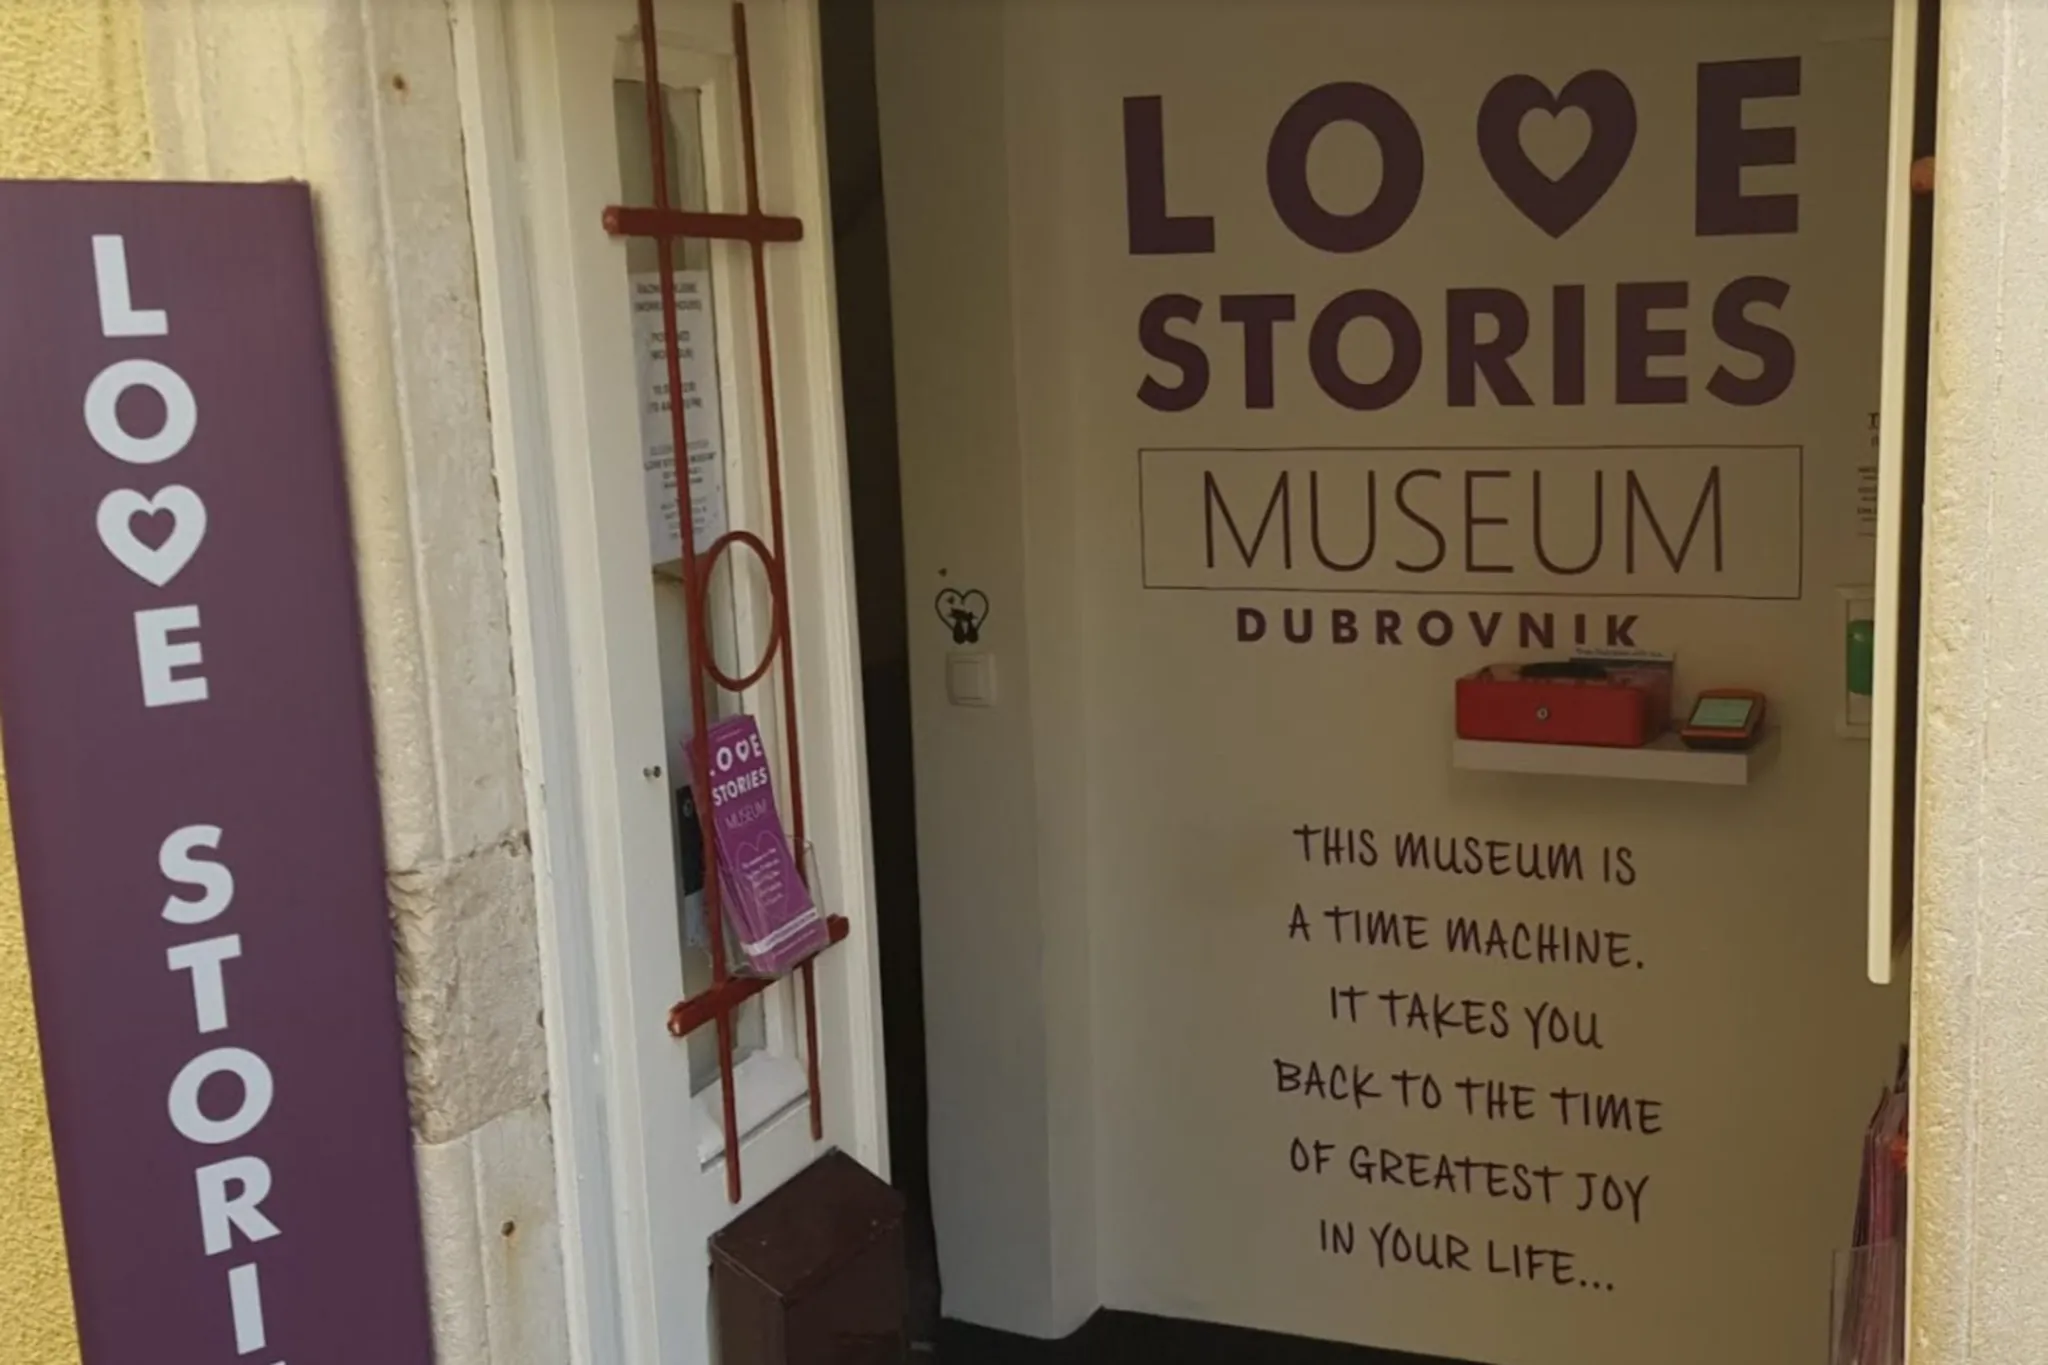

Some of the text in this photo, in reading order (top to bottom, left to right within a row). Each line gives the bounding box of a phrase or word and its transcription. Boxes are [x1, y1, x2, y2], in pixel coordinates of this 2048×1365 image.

[1137, 275, 1796, 412] STORIES
[1202, 466, 1723, 576] MUSEUM
[1236, 608, 1640, 649] DUBROVNIK
[712, 767, 768, 806] STORIES
[1293, 824, 1636, 886] THIS MUSEUM IS
[1288, 903, 1644, 969] A TIME MACHINE.
[1330, 985, 1604, 1050] IT TAKES YOU
[158, 824, 286, 1365] STORI
[1273, 1059, 1662, 1135] BACK TO THE TIME
[1290, 1137, 1650, 1223] OF GREATEST JOY
[1320, 1219, 1614, 1291] IN YOUR LIFE...
